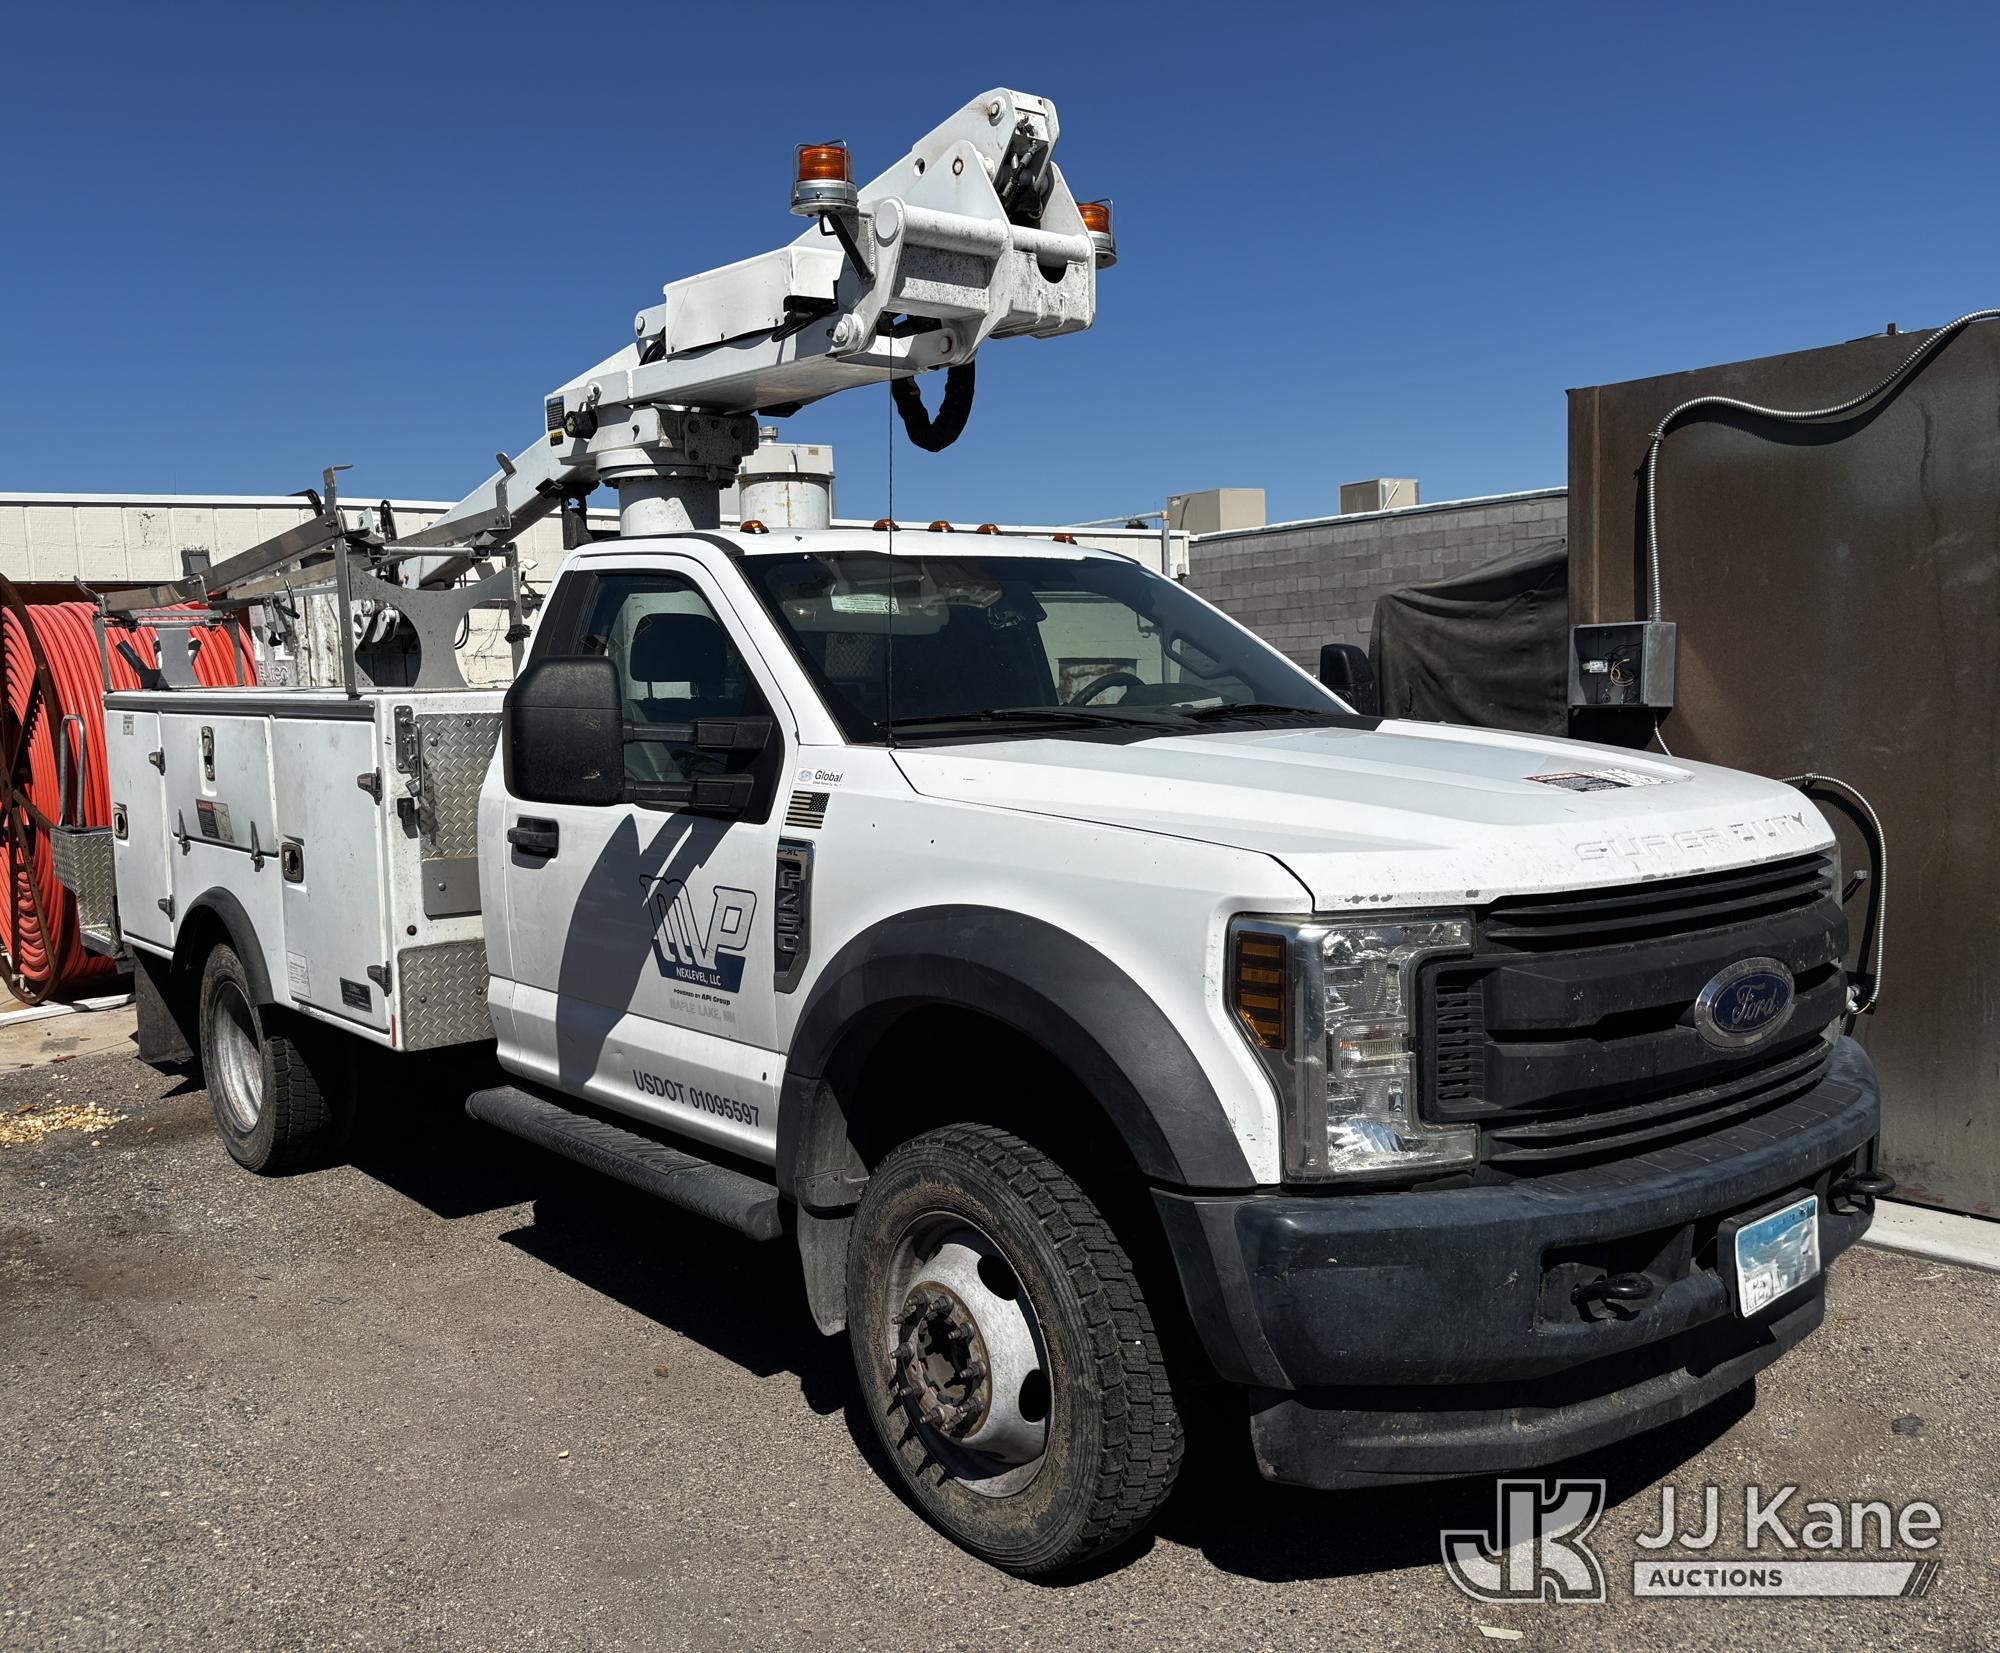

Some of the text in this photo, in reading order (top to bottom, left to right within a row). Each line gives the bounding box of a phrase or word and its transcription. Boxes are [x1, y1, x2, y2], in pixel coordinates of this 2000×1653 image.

[815, 769, 844, 782] Global
[1573, 811, 1811, 862] SUPER DUTY
[786, 848, 798, 856] XL
[676, 967, 722, 986] NEXLEVEL, LLC
[701, 993, 712, 1002] API
[712, 996, 731, 1006] Group
[1731, 982, 1779, 1025] Ford
[632, 1069, 759, 1127] USDOT 01095597
